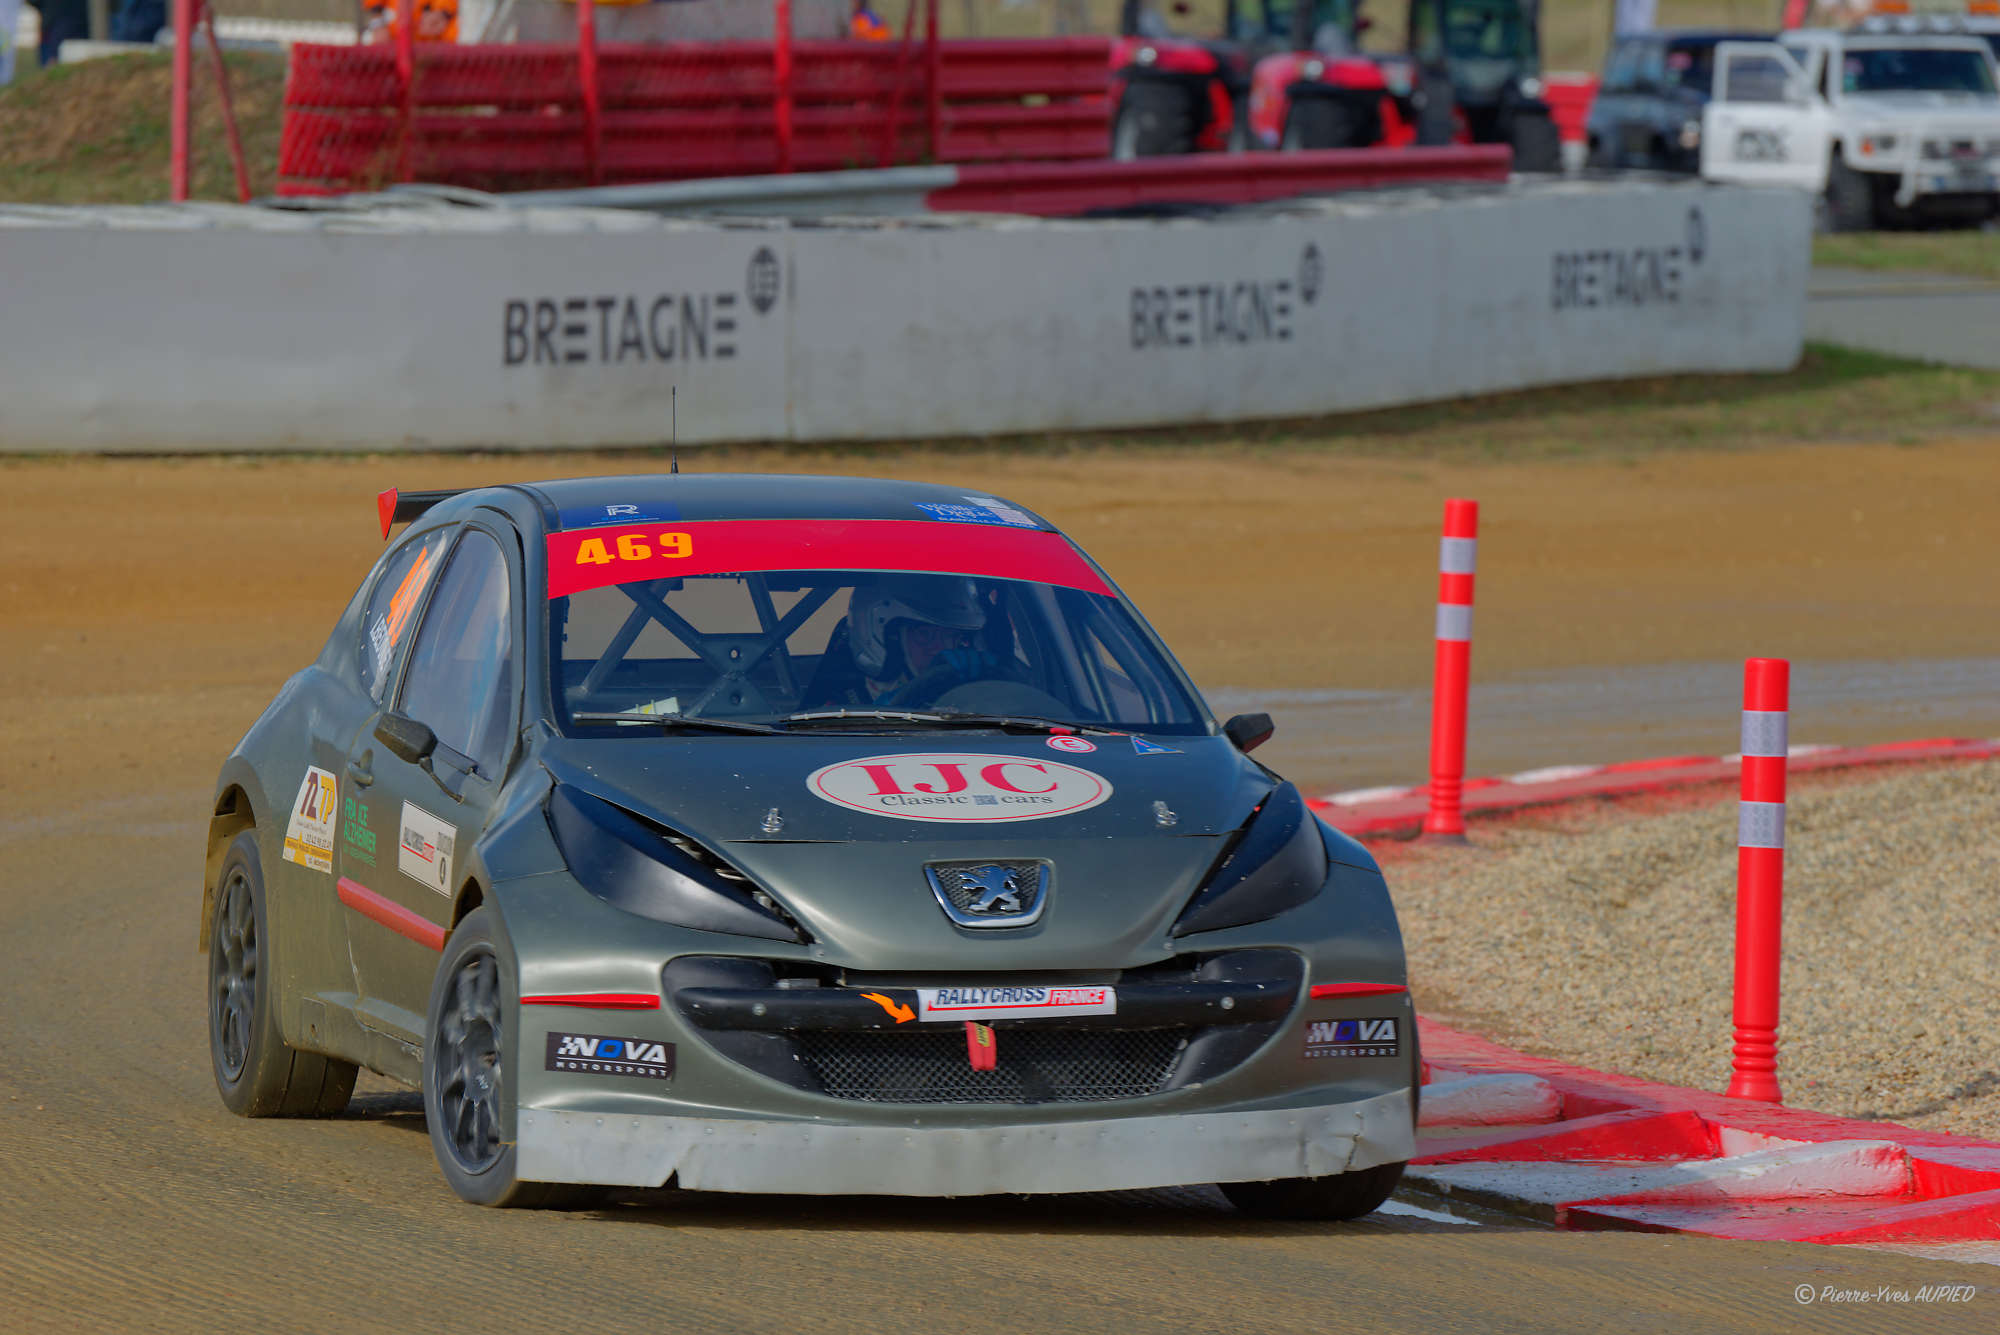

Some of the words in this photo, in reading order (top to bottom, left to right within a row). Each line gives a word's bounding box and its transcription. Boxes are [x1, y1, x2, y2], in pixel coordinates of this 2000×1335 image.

[1552, 248, 1681, 310] BRETAGNE
[1131, 281, 1291, 348] BRETAGNE
[503, 294, 737, 365] BRETAGNE
[576, 532, 693, 565] 469
[851, 763, 1058, 795] IJC
[880, 794, 968, 806] Classic
[1001, 796, 1054, 805] cars
[936, 987, 1046, 1005] RALLYCROSS
[1050, 989, 1105, 1005] FRANCE
[1307, 1020, 1396, 1043] NOVA
[557, 1036, 667, 1063] NOVA
[1304, 1048, 1397, 1058] MOTORSPORT
[556, 1061, 667, 1077] MOTORSPORT
